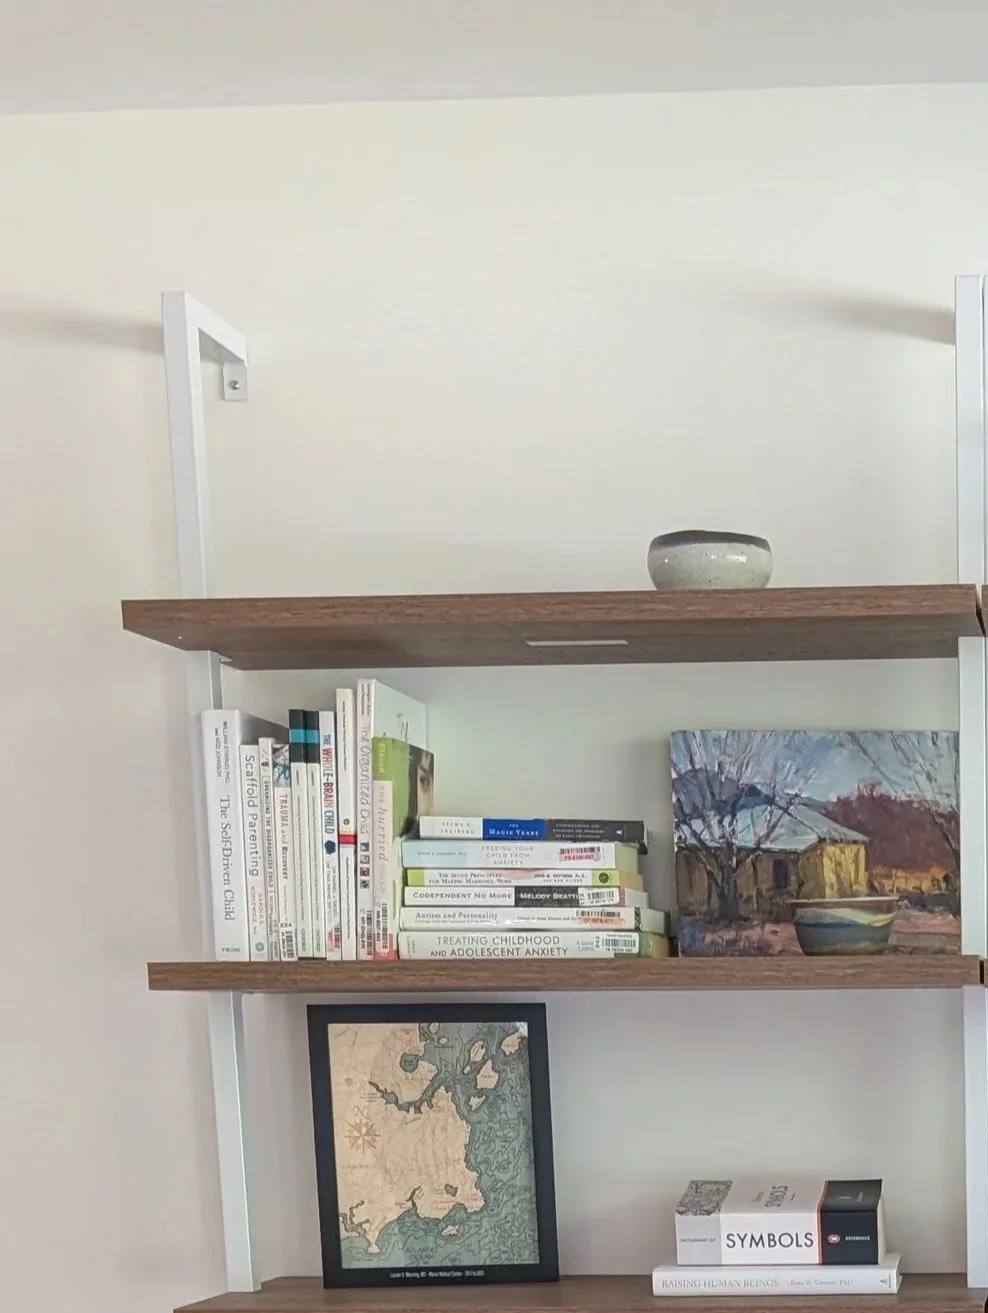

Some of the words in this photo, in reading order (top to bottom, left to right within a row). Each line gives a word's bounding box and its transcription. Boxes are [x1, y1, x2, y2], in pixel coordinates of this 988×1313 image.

[244, 754, 258, 808] Scaffold
[219, 794, 231, 819] The
[220, 822, 233, 886] Self-Driven
[248, 813, 261, 876] Parenting
[224, 890, 235, 921] Child
[412, 892, 471, 900] CODEPENDENT
[474, 892, 486, 900] NO
[489, 892, 512, 900] MORE
[436, 936, 488, 946] TREATING
[492, 936, 560, 946] CHILDHOOD
[450, 948, 520, 957] ADOLESCENT
[524, 947, 568, 957] ANXIETY
[726, 1232, 814, 1249] SYMBOLS
[661, 1278, 701, 1288] RAISING
[703, 1278, 740, 1288] HUMAN
[742, 1278, 780, 1288] BEINGS
